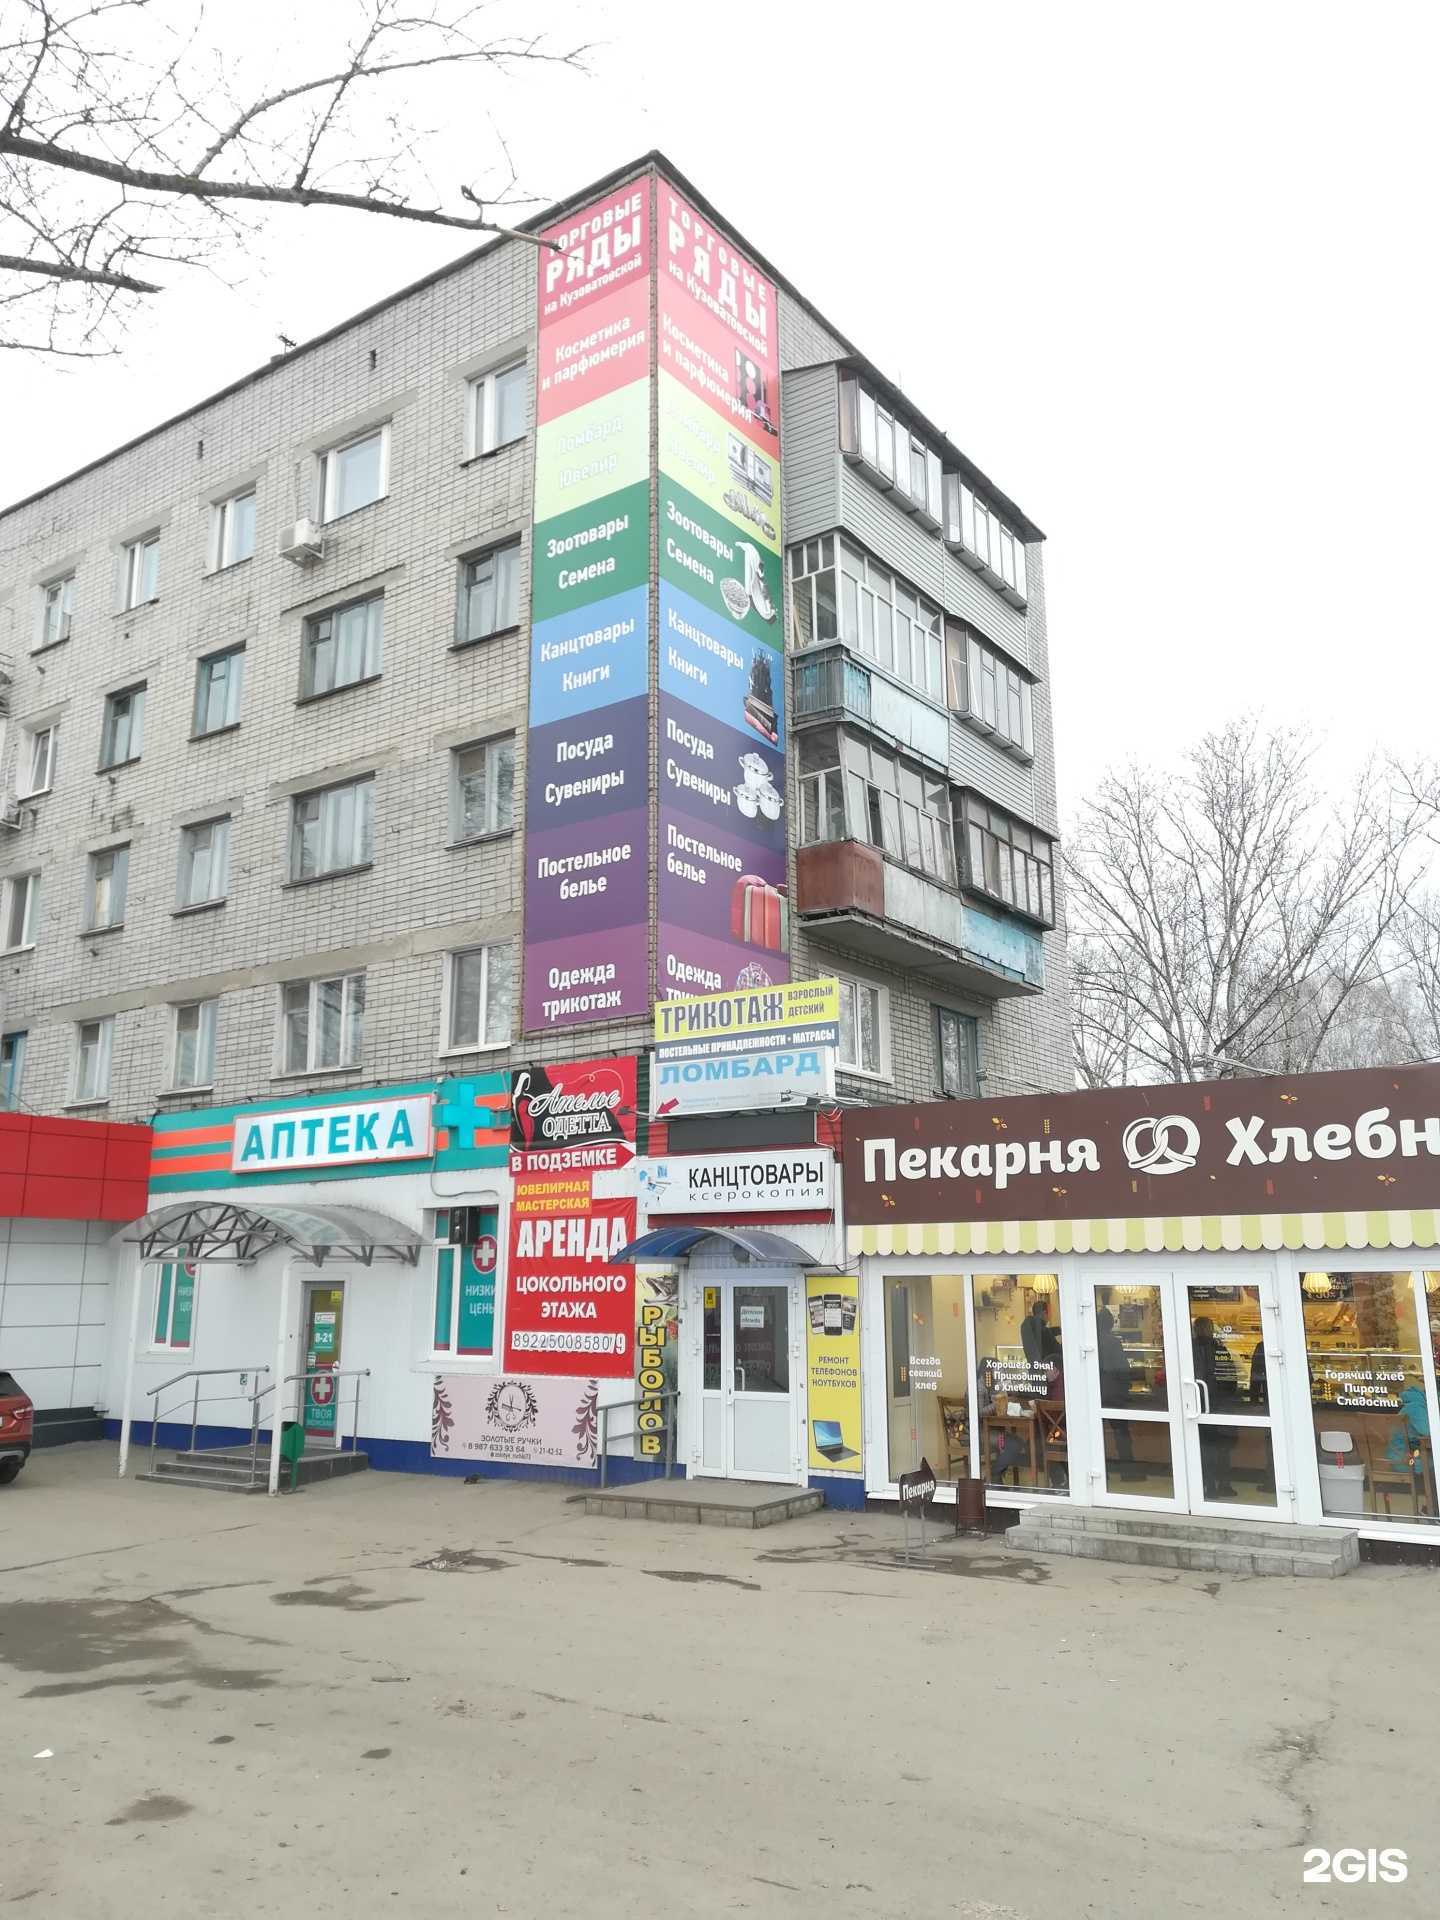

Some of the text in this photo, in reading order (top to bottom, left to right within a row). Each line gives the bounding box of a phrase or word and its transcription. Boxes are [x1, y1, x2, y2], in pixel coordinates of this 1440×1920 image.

[546, 214, 641, 293] РЯДЫ
[669, 196, 767, 303] ТОРГОВЫЕ
[544, 254, 642, 316] на Кузоватовской
[668, 218, 767, 337] РЯДЫ
[668, 260, 768, 358] на Кузоватовской
[555, 314, 631, 363] Косметика
[663, 312, 729, 383] Косметика
[542, 330, 646, 391] и парфюмерия
[663, 340, 752, 424] и парфюмерия
[547, 514, 629, 558] Зоотовары
[667, 500, 733, 562] Зоотовары
[558, 555, 615, 590] Семена
[667, 538, 714, 585] Семена
[541, 618, 635, 663] Канцтовары
[668, 608, 744, 670] Канцтовары
[562, 664, 610, 692] Книги
[668, 646, 708, 686] Книги
[557, 733, 614, 763] Посуда
[667, 718, 714, 760] Посуда
[545, 769, 625, 806] Сувениры
[667, 758, 731, 806] Сувениры
[538, 843, 632, 878] Постельное
[667, 824, 743, 872] Постельное
[667, 852, 707, 885] белье
[560, 875, 607, 900] белье
[549, 962, 616, 990] Одежда
[666, 954, 722, 991] Одежда
[543, 989, 622, 1021] трикотаж
[788, 985, 834, 1001] ВЗРОСЛЫЙ
[660, 992, 784, 1034] ТРИКОТАЖ
[788, 1003, 825, 1018] ДЕТСКИЙ
[659, 1029, 836, 1059] ПОСТЕЛЬНЫЕ ПРИНАДЛЕЖНОСТИ МАТРАСЫ
[660, 1052, 821, 1085] ЛОМБАРД
[526, 1082, 622, 1117] Ателье
[240, 1109, 414, 1162] АПТЕКА
[542, 1112, 612, 1141] ОДЕТТА
[511, 1148, 617, 1172] В ПОДЗЕМКЕ
[689, 1161, 824, 1190] КАНЦТОВАРЫ
[863, 1136, 1100, 1189] Пекарня
[516, 1198, 590, 1211] МАСТЕРСКАЯ
[517, 1181, 590, 1196] ЮВЕЛИРНАЯ
[689, 1187, 824, 1202] ксерокопия
[516, 1216, 628, 1263] АРЕНДА
[516, 1275, 626, 1294] ЦОКОЛЬНОГО
[540, 1301, 597, 1319] ЭТАЖА
[811, 1367, 858, 1377] ТЕЛЕФОНОВ
[818, 1356, 849, 1365] РЕМОНТ
[908, 1368, 943, 1379] свежий
[909, 1356, 941, 1368] Всегда
[986, 1359, 1054, 1371] Хорошего дня!
[1325, 1369, 1405, 1382] Горячий хлеб
[638, 1305, 667, 1456] РЫБОЛОВ
[812, 1379, 857, 1389] НОУТБУКОВ
[914, 1381, 938, 1391] хлеб
[993, 1371, 1047, 1383] Приходите
[1001, 1382, 1048, 1396] Хлебницу
[1344, 1383, 1388, 1395] Пироги
[1336, 1396, 1399, 1408] Сладости
[480, 1434, 516, 1444] ЗОЛОТЫЕ
[902, 1479, 935, 1501] Пекарня
